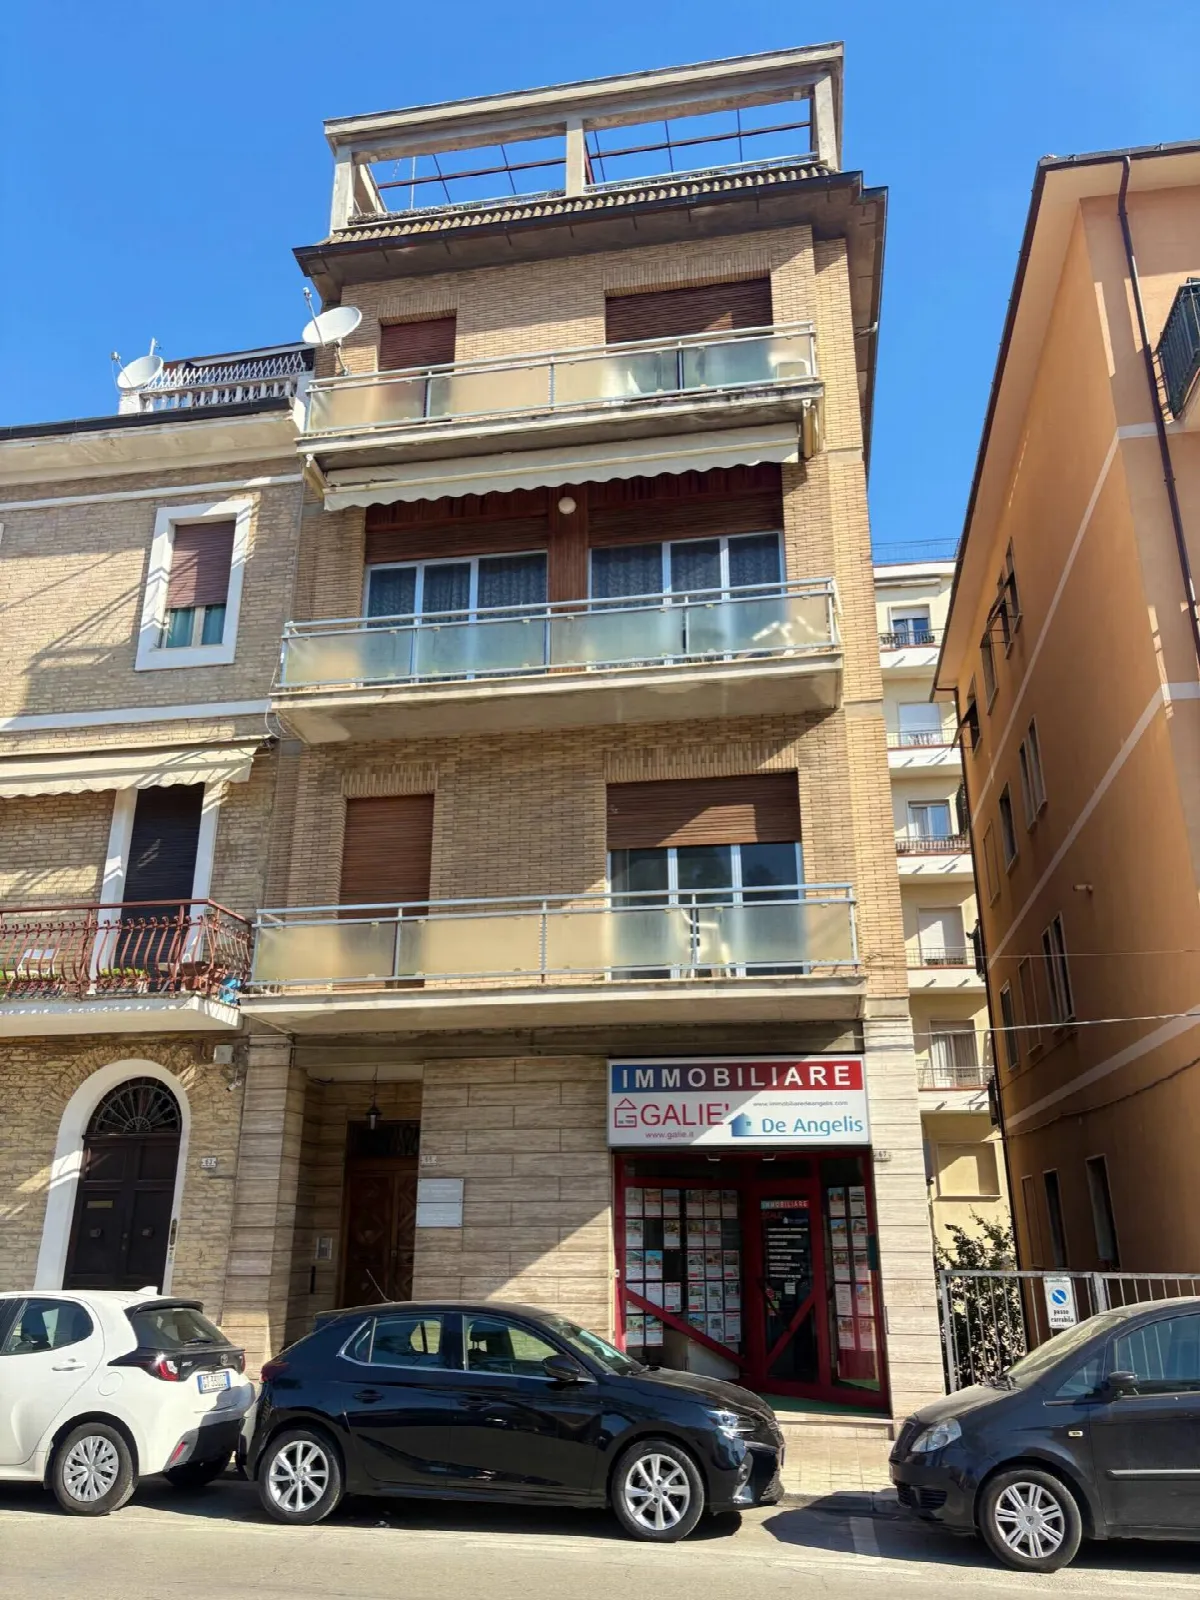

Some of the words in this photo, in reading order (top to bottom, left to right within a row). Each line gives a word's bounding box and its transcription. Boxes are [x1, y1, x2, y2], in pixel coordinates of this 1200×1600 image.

[622, 1065, 851, 1089] IMMOBILIARE
[752, 1100, 849, 1108] www.immobiliaredeangelis.com
[640, 1103, 729, 1126] GALIE'
[762, 1118, 787, 1133] De
[793, 1115, 864, 1137] Angelis
[645, 1131, 694, 1140] www.galie.it
[1053, 1309, 1070, 1317] passo
